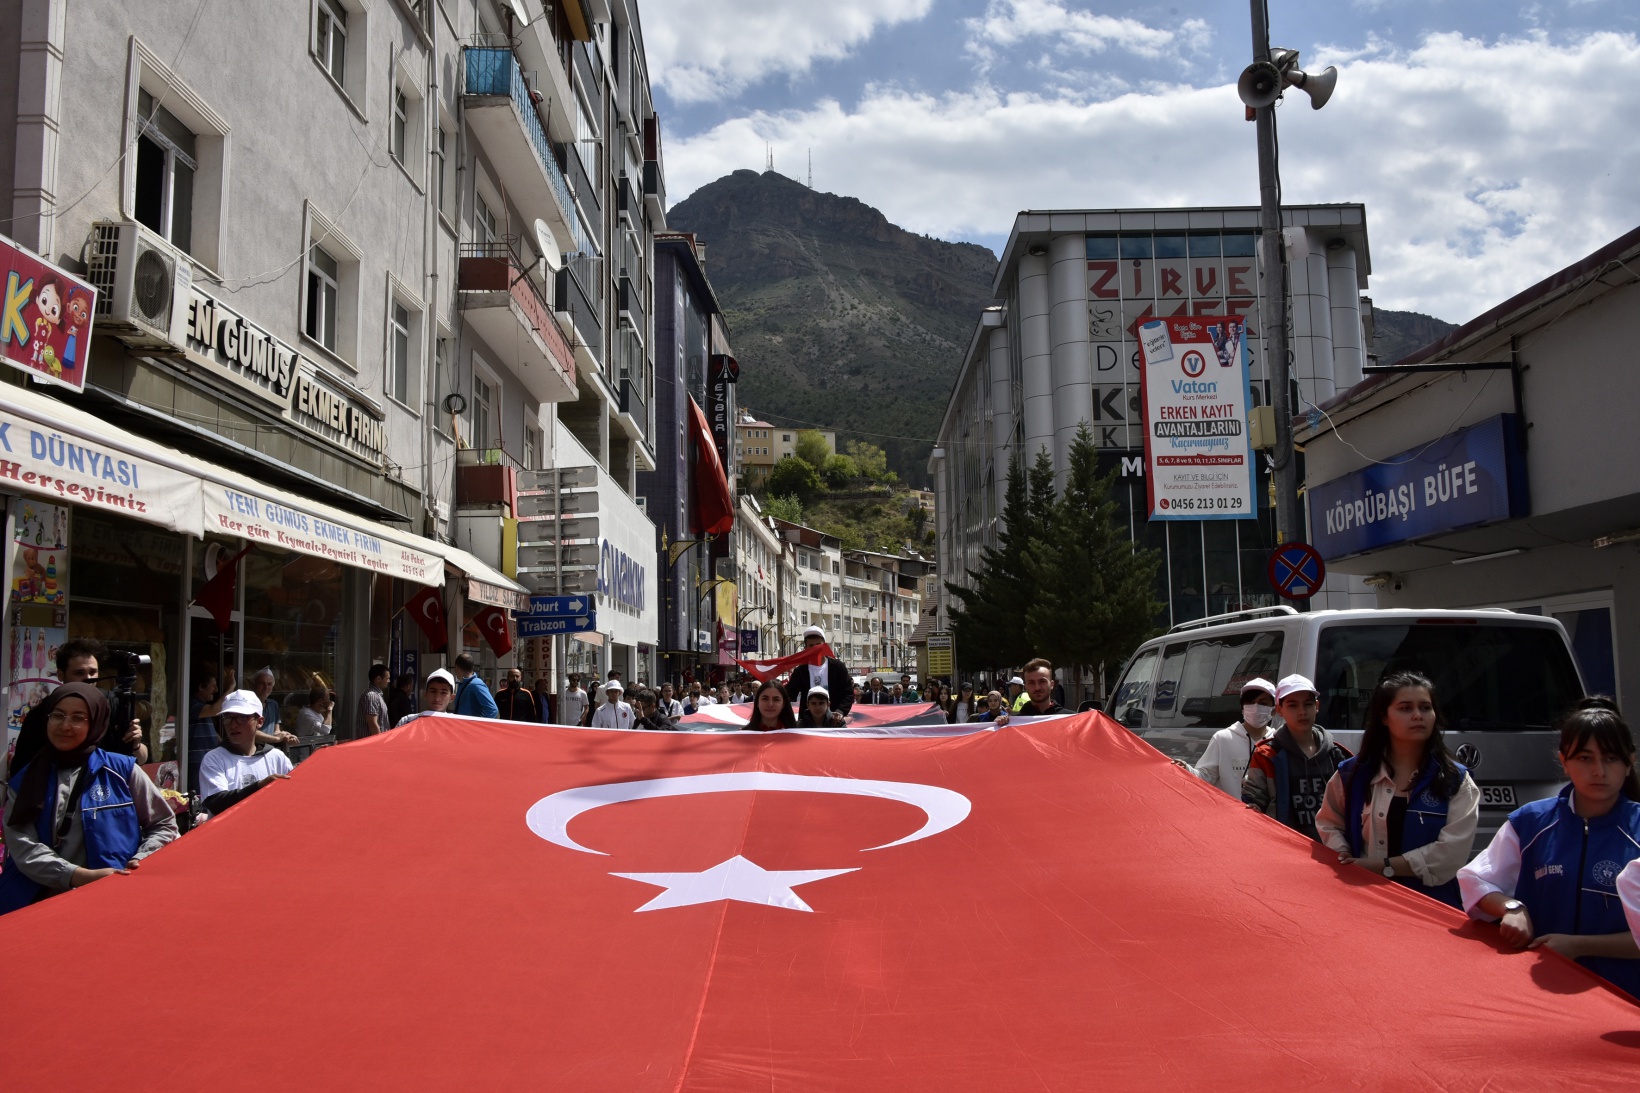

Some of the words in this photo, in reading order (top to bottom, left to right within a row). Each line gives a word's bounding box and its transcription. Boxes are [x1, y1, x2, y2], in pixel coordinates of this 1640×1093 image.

[187, 299, 219, 350] ENİ
[223, 317, 293, 397] GÜMÜŞ
[1171, 380, 1217, 394] Vatan
[298, 380, 349, 435] EKMEK
[714, 382, 726, 432] EZBER
[1160, 406, 1198, 420] ERKEN
[1201, 404, 1234, 419] KAYIT
[30, 430, 139, 489] DÜNYASI
[1173, 473, 1190, 481] KAYIT
[0, 459, 147, 513] Herşeyimiz
[1171, 498, 1194, 509] 0456
[1197, 498, 1214, 509] 213
[1217, 498, 1228, 508] 01
[1230, 497, 1242, 508] 29
[1326, 482, 1416, 535] KÖPRÜBAŞI
[1424, 460, 1478, 507] BÜFE
[224, 489, 260, 518] YENİ
[314, 519, 350, 546] EKMEK
[218, 513, 243, 532] Her
[247, 523, 270, 540] gün
[529, 601, 559, 615] yburt
[522, 619, 566, 633] Trabzon
[1298, 778, 1322, 794] BE
[1482, 787, 1513, 803] 598
[1548, 864, 1563, 877] GENÇ
